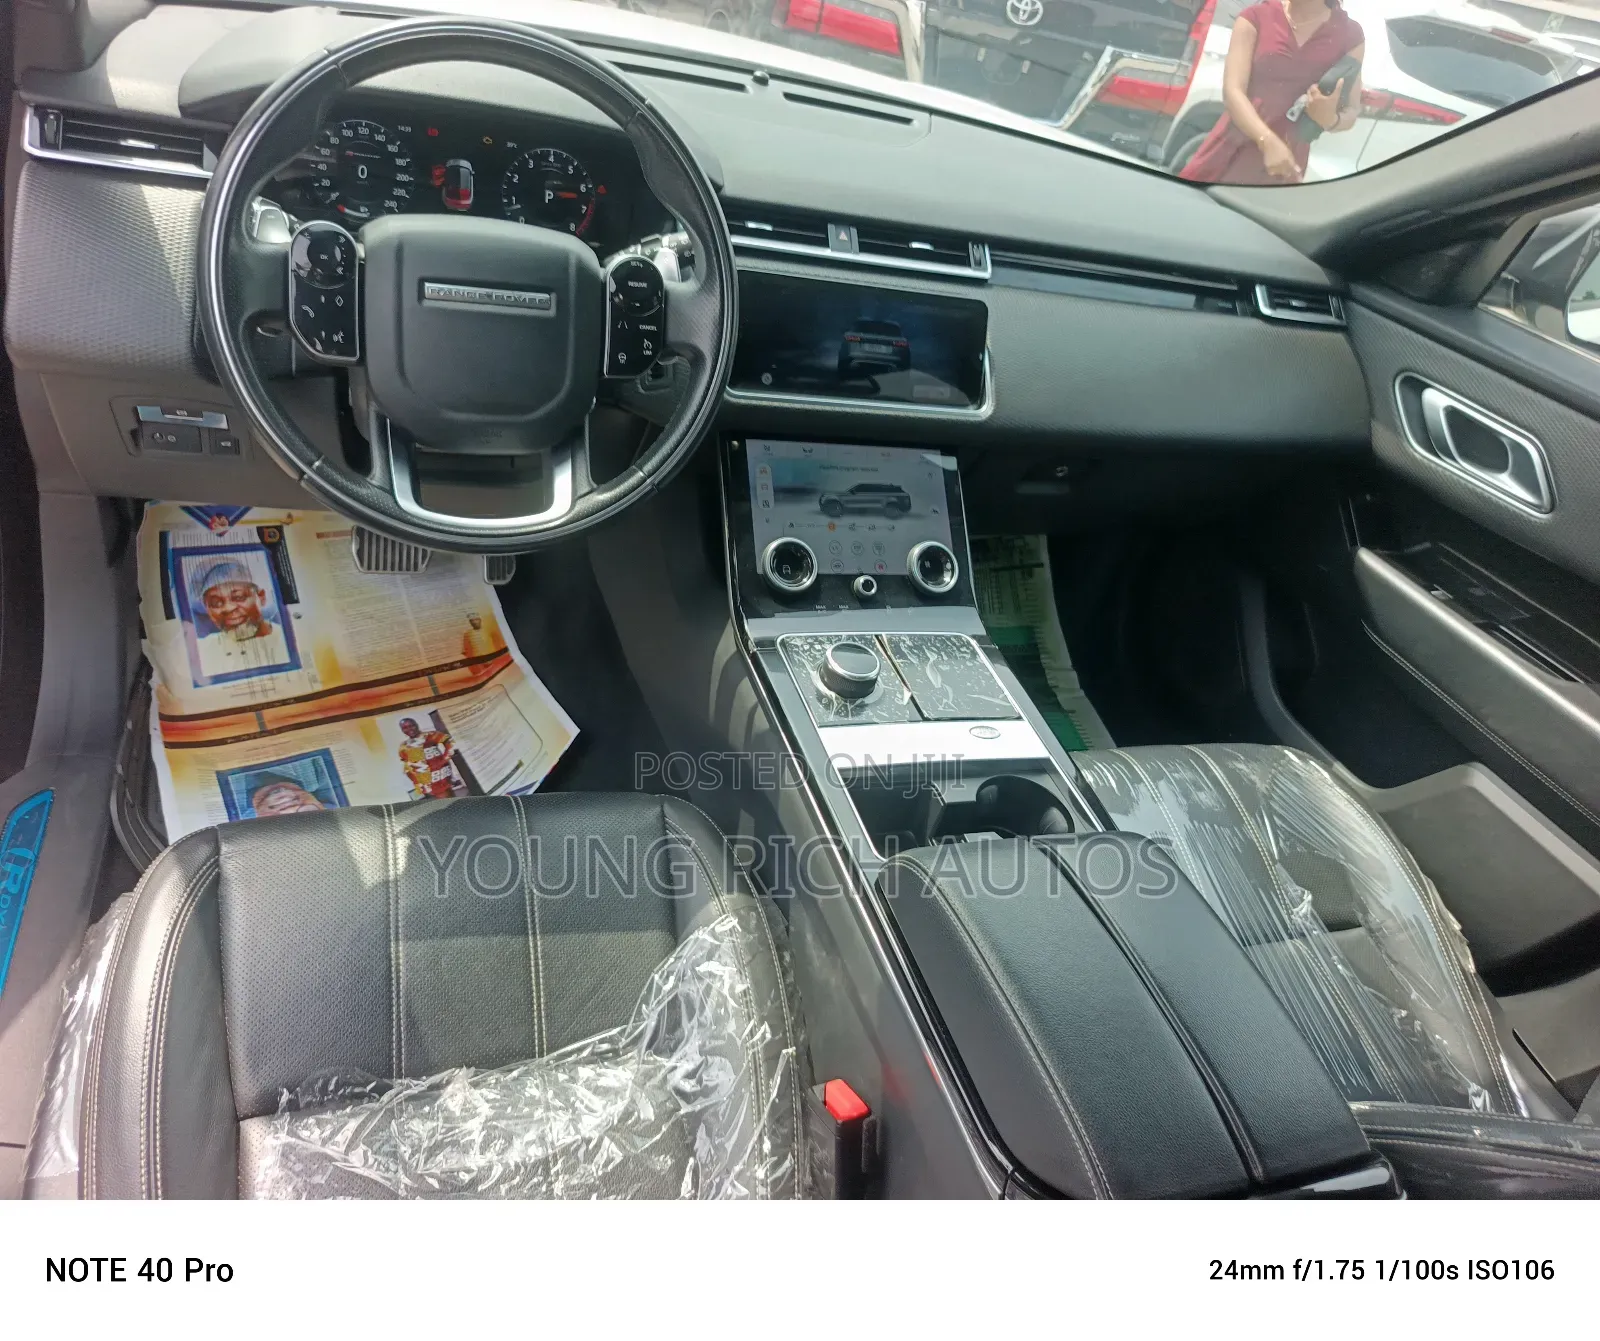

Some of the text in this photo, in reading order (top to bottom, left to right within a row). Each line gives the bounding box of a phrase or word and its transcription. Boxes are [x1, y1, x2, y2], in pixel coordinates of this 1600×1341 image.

[341, 129, 354, 138] 100
[357, 127, 370, 135] 120
[329, 136, 340, 145] 80
[374, 134, 386, 142] 140
[320, 148, 331, 156] 60
[386, 144, 399, 153] 160
[395, 158, 407, 167] 180
[548, 155, 555, 163] 4
[317, 163, 328, 171] 40
[527, 159, 534, 169] 3
[357, 165, 368, 179] 0
[567, 165, 574, 175] 5
[395, 173, 410, 182] 200
[512, 174, 519, 183] 2
[320, 178, 331, 187] 20
[392, 188, 406, 197] 220
[579, 183, 587, 193] 6
[511, 195, 516, 205] 1
[544, 189, 554, 204] P
[383, 199, 398, 208] 240
[581, 204, 587, 214] 7
[569, 222, 576, 232] 8
[429, 287, 488, 301] RANGE
[639, 323, 658, 332] CANCEL
